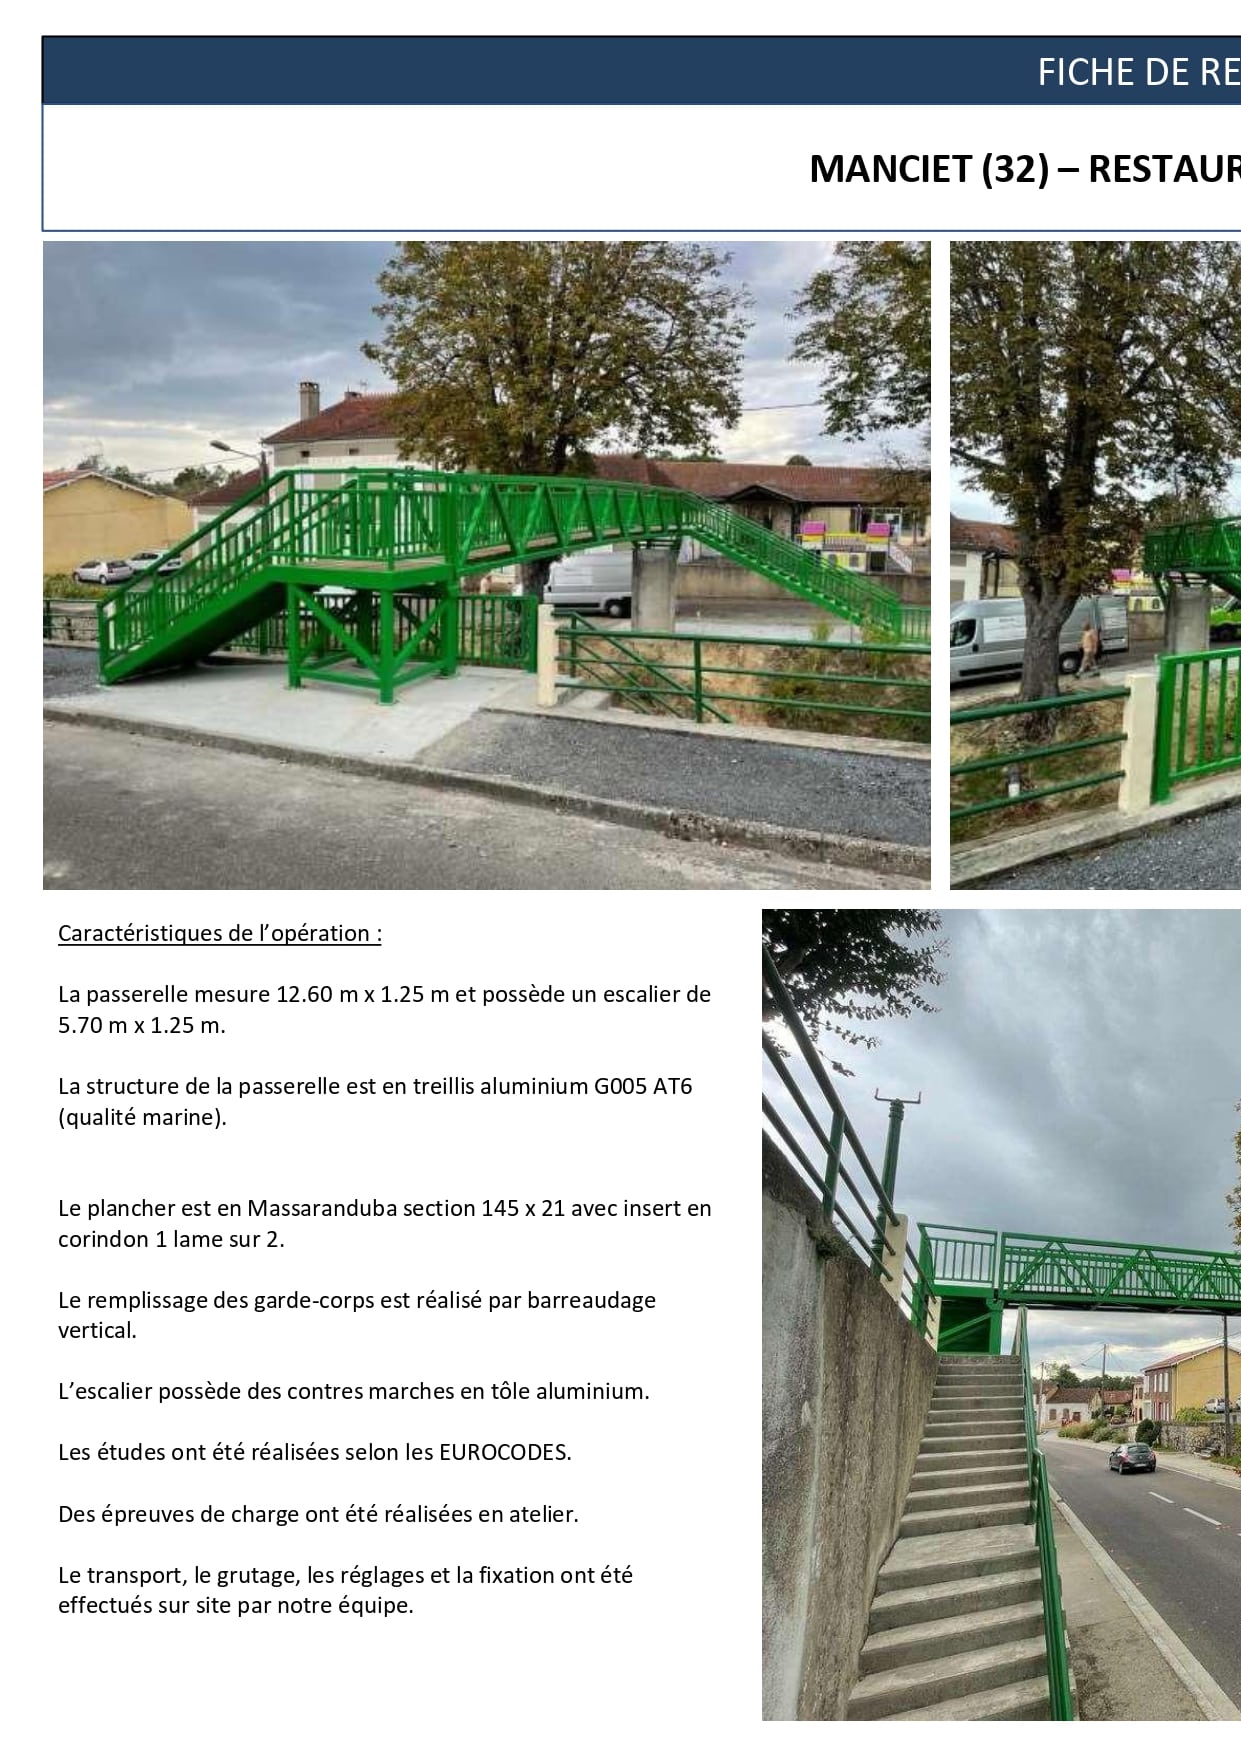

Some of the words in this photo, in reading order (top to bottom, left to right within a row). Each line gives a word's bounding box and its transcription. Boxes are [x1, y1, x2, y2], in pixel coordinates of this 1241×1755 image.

[1039, 57, 1134, 86] FICHE
[1146, 57, 1189, 86] DE
[811, 154, 974, 183] MANCIET
[982, 152, 1049, 190] (32)
[58, 922, 223, 944] Caractéristiques
[228, 923, 253, 942] de
[59, 985, 80, 1003] La
[87, 984, 188, 1007] passerelle
[195, 989, 270, 1003] mesure
[277, 985, 333, 1003] 12.60
[340, 989, 358, 1003] m
[363, 989, 375, 1003] x
[381, 985, 424, 1003] 1.25
[431, 989, 449, 1003] m
[455, 986, 477, 1003] et
[483, 983, 565, 1007] possède
[572, 989, 597, 1003] un
[603, 984, 681, 1003] escalier
[686, 984, 711, 1003] de
[58, 1016, 103, 1034] 5.70
[109, 1020, 127, 1034] m
[133, 1020, 145, 1034] x
[151, 1016, 194, 1034] 1.25
[201, 1020, 226, 1034] m.
[59, 1077, 80, 1095] La
[86, 1078, 179, 1095] structure
[185, 1076, 210, 1095] de
[217, 1076, 232, 1095] la
[239, 1076, 340, 1099] passerelle
[346, 1078, 377, 1095] est
[382, 1081, 407, 1095] en
[412, 1076, 475, 1095] treillis
[480, 1076, 588, 1095] aluminium
[594, 1077, 647, 1095] G005
[652, 1077, 693, 1095] AT6
[58, 1106, 136, 1130] (qualité
[143, 1107, 227, 1130] marine).
[59, 1199, 81, 1217] Le
[88, 1198, 176, 1221] plancher
[181, 1200, 212, 1217] est
[217, 1203, 241, 1217] en
[248, 1198, 397, 1217] Massaranduba
[403, 1199, 475, 1217] section
[482, 1199, 519, 1217] 145
[524, 1203, 536, 1217] x
[541, 1199, 565, 1217] 21
[571, 1203, 618, 1217] avec
[623, 1199, 682, 1217] insert
[687, 1203, 711, 1217] en
[58, 1229, 149, 1248] corindon
[156, 1230, 168, 1248] 1
[174, 1229, 223, 1248] lame
[229, 1234, 261, 1248] sur
[266, 1230, 285, 1248] 2.
[59, 1291, 81, 1309] Le
[88, 1290, 208, 1313] remplissage
[213, 1290, 249, 1309] des
[254, 1290, 375, 1313] garde-corps
[380, 1292, 411, 1309] est
[417, 1289, 482, 1309] réalisé
[489, 1295, 522, 1313] par
[528, 1290, 656, 1313] barreaudage
[57, 1320, 137, 1339] vertical.
[159, 1380, 241, 1404] possède
[247, 1381, 282, 1400] des
[287, 1383, 364, 1400] contres
[369, 1381, 455, 1400] marches
[460, 1386, 485, 1400] en
[490, 1380, 530, 1400] tôle
[536, 1381, 650, 1400] aluminium.
[59, 1443, 91, 1461] Les
[97, 1441, 166, 1461] études
[171, 1444, 207, 1461] ont
[212, 1441, 245, 1461] été
[252, 1441, 340, 1461] réalisées
[345, 1442, 399, 1461] selon
[406, 1442, 434, 1461] les
[440, 1443, 572, 1461] EUROCODES.
[59, 1505, 96, 1523] Des
[101, 1503, 195, 1527] épreuves
[200, 1504, 225, 1523] de
[231, 1504, 299, 1527] charge
[305, 1506, 340, 1523] ont
[345, 1503, 378, 1523] été
[385, 1503, 473, 1523] réalisées
[478, 1509, 503, 1523] en
[509, 1504, 579, 1523] atelier.
[59, 1566, 81, 1584] Le
[86, 1567, 188, 1588] transport,
[195, 1565, 211, 1584] le
[217, 1567, 301, 1588] grutage,
[308, 1565, 335, 1584] les
[341, 1564, 425, 1588] réglages
[430, 1567, 451, 1584] et
[457, 1565, 473, 1584] la
[478, 1565, 555, 1584] fixation
[560, 1567, 596, 1584] ont
[600, 1564, 633, 1584] été
[58, 1594, 153, 1614] effectués
[158, 1600, 190, 1614] sur
[196, 1596, 231, 1614] site
[238, 1600, 272, 1618] par
[278, 1597, 332, 1614] notre
[338, 1594, 414, 1618] équipe.
